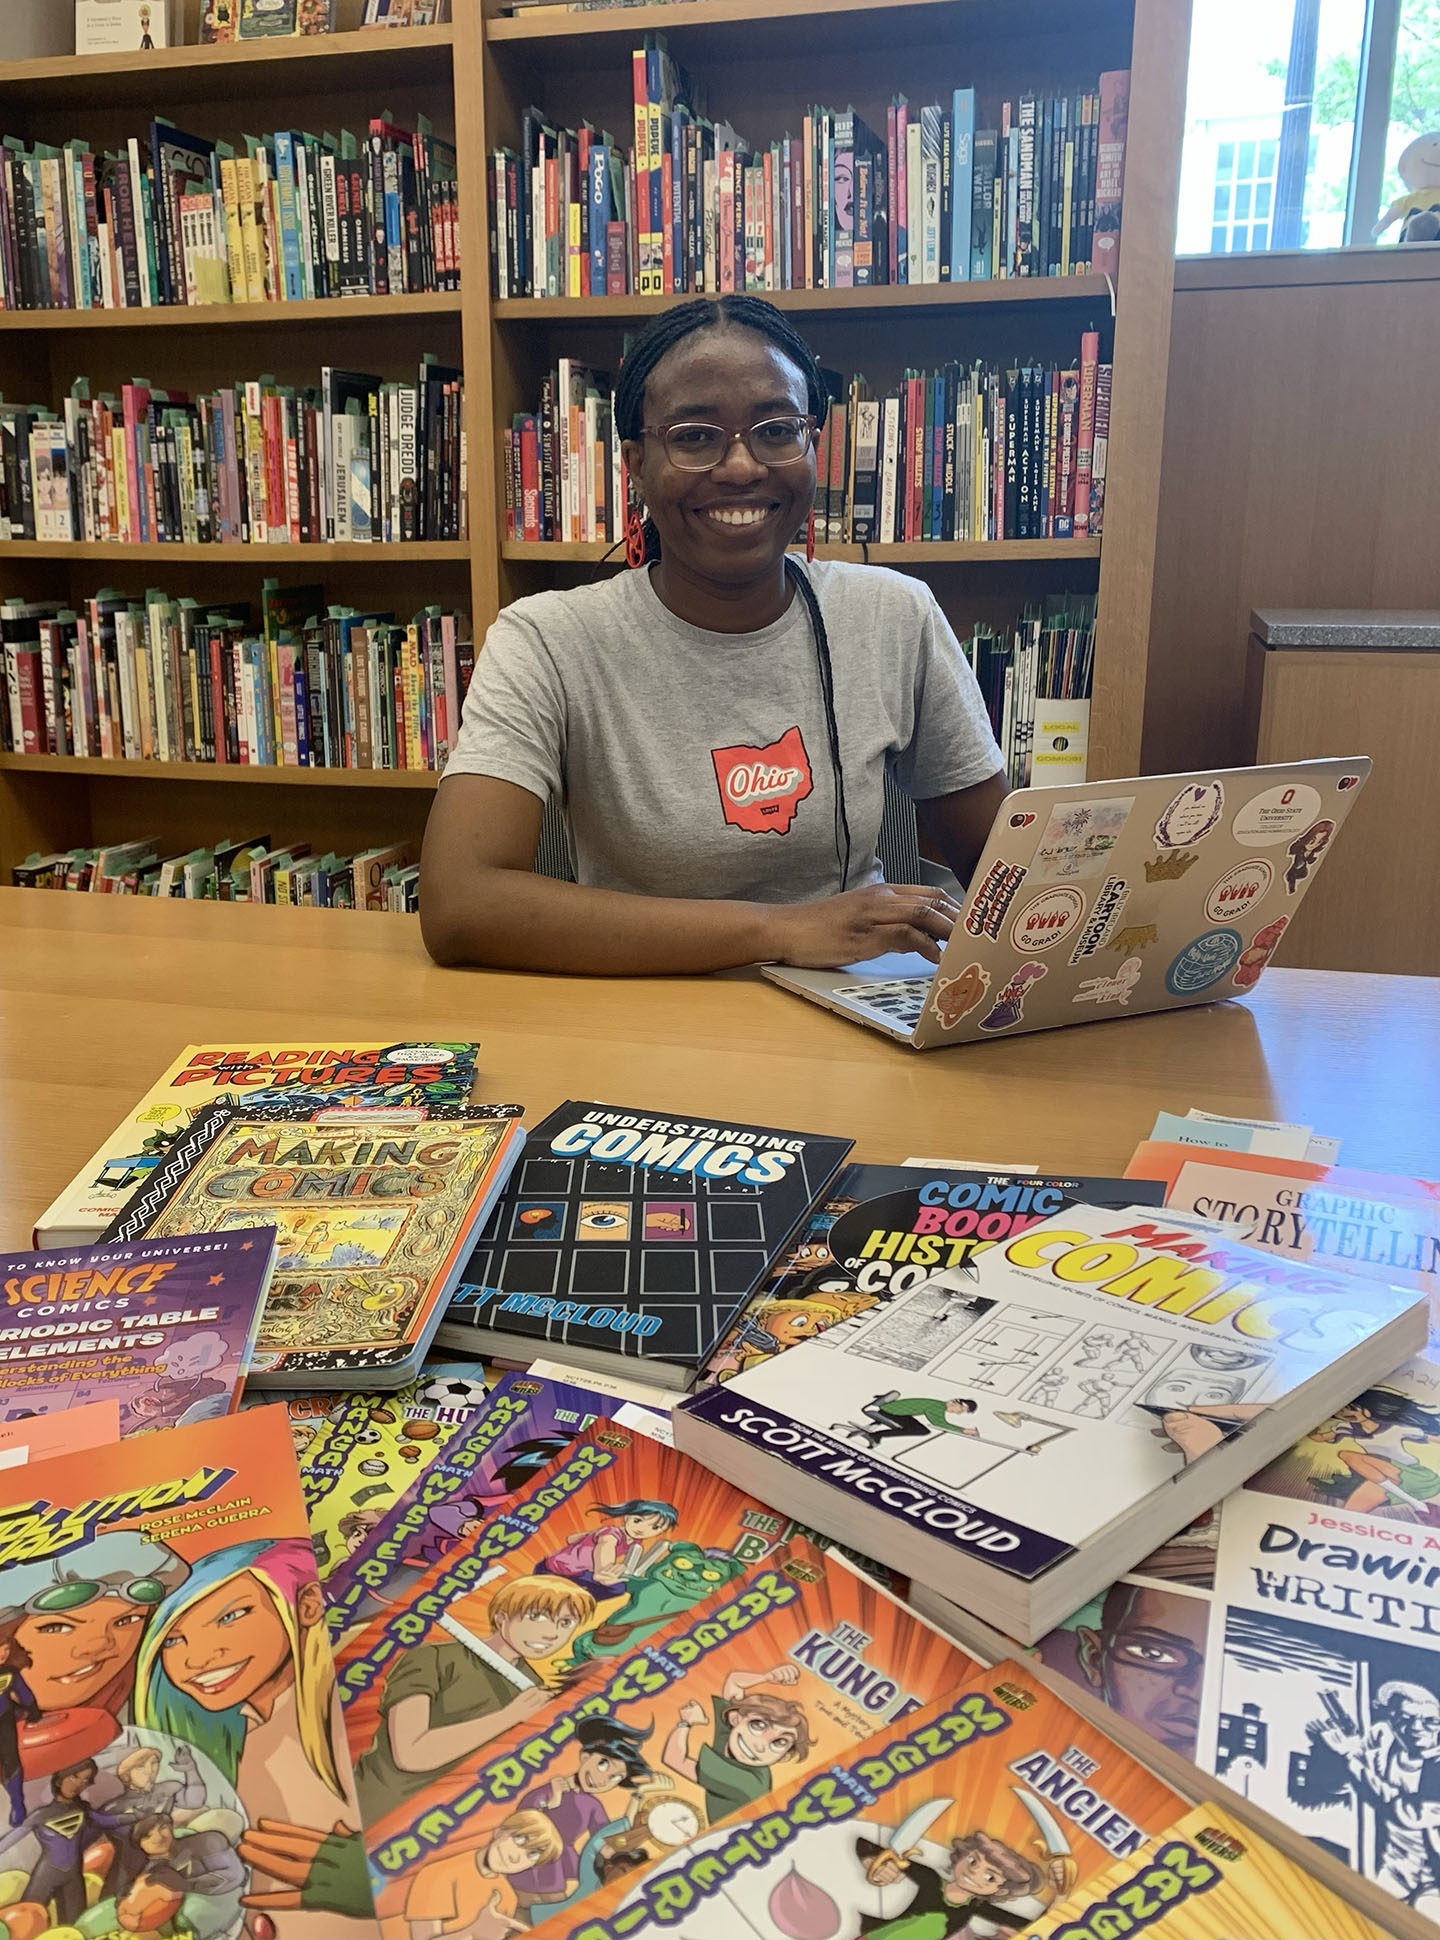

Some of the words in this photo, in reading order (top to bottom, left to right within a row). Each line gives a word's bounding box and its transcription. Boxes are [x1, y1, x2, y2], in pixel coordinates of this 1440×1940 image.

[1021, 101, 1035, 126] THE
[637, 119, 647, 158] POPEYE
[650, 117, 660, 156] POPEYE
[956, 133, 970, 165] Saga
[1019, 127, 1035, 190] SANDMAN
[118, 162, 132, 216] FROM
[307, 173, 317, 212] GREEN
[322, 168, 333, 193] GREEN
[594, 153, 604, 204] POGO
[859, 167, 868, 198] Believe
[983, 164, 992, 209] SAILOR
[325, 194, 335, 217] RIVER
[673, 181, 681, 224] POTENTIAL
[122, 222, 136, 268] HELL
[311, 214, 320, 265] LANTERN
[327, 218, 337, 244] KILLER
[340, 220, 350, 264] OMNIBUS
[355, 219, 364, 262] OMNIBUS
[368, 393, 377, 417] JINX
[401, 392, 414, 429] JUDGE
[1082, 360, 1096, 432] SUPERMAN
[401, 434, 414, 474] DREDD
[544, 433, 552, 473] SENSITIVE
[915, 427, 923, 453] STRAY
[946, 423, 954, 450] STUCK
[1008, 414, 1016, 483] SUPERMAN
[287, 445, 298, 478] IRON
[914, 454, 922, 488] BULLETS
[945, 463, 953, 494] MIDDLE
[1021, 449, 1029, 503] ACTION
[288, 482, 299, 520] BOUND
[336, 463, 347, 523] JERUSALEM
[524, 489, 538, 528] Seconds
[1058, 519, 1070, 529] DC
[356, 655, 364, 668] LOS
[235, 686, 243, 715] BITCH
[359, 704, 367, 719] LOST
[359, 721, 368, 743] CAUSE
[728, 763, 799, 802] Ohio
[965, 860, 1010, 937] CAPTAIN
[984, 864, 1027, 941] AMERICA
[1093, 876, 1116, 917] LIBRARY
[1213, 905, 1224, 917] GO
[1223, 900, 1251, 917] GRAD!
[1081, 880, 1125, 957] CARTOON
[1021, 934, 1032, 946] GO
[1032, 930, 1062, 947] GRAD!
[1071, 923, 1093, 963] MUSEUM
[169, 1065, 445, 1087] PICTURES
[186, 1048, 382, 1068] READING
[217, 1062, 254, 1071] with
[583, 1111, 807, 1153] UNDERSTANDING
[1178, 1135, 1209, 1145] How
[222, 1137, 461, 1168] MAKING
[550, 1123, 797, 1186] COMICS
[202, 1167, 449, 1200] COMICS
[536, 1156, 572, 1166] THE
[587, 1163, 709, 1188] INVISIBLE
[724, 1184, 766, 1195] ART
[986, 1176, 1010, 1186] THE
[1016, 1178, 1043, 1187] FOUR
[1045, 1180, 1080, 1188] COLOR
[918, 1180, 1064, 1214] COMIC
[1276, 1189, 1397, 1226] GRAPHIC
[7, 1262, 26, 1272] TO
[34, 1257, 82, 1269] KNOW
[90, 1252, 134, 1264] YOUR
[141, 1243, 228, 1258] UNIVERSE!
[844, 1257, 867, 1269] OF
[1104, 1223, 1349, 1295] MAKING
[4, 1262, 177, 1306] SCIENCE
[1005, 1230, 1384, 1353] COMICS
[17, 1298, 130, 1319] COMICS
[120, 1306, 220, 1330] TABLE
[498, 1292, 663, 1336] McCLOUD
[48, 1373, 70, 1384] of
[71, 1362, 167, 1383] Everything
[102, 1354, 133, 1365] the
[318, 1393, 383, 1468] MANGA
[404, 1406, 431, 1420] THE
[449, 1395, 528, 1468] MANGA
[554, 1408, 580, 1424] THE
[719, 1407, 839, 1469] SCOTT
[301, 1466, 344, 1476] MATH
[433, 1463, 475, 1478] MATH
[515, 1443, 612, 1523] MANGA
[789, 1421, 811, 1435] FROM
[811, 1431, 826, 1443] THE
[826, 1438, 859, 1457] AUTHOR
[857, 1453, 871, 1463] OF
[869, 1460, 937, 1497] UNDERSTANDING
[937, 1493, 977, 1514] COMICS
[139, 1513, 184, 1533] ROSE
[186, 1496, 253, 1521] McCLAIN
[139, 1522, 204, 1546] SERENA
[206, 1505, 273, 1529] GUERRA
[498, 1513, 540, 1533] MATH
[742, 1510, 783, 1535] THE
[1306, 1511, 1413, 1546] Jessica
[667, 1572, 797, 1666] MANGA
[834, 1620, 872, 1651] THE
[644, 1645, 686, 1679] MATH
[792, 1630, 898, 1713] KUNG
[856, 1695, 1004, 1790] MANGA
[1064, 1746, 1100, 1778] THE
[832, 1766, 878, 1805] MATH
